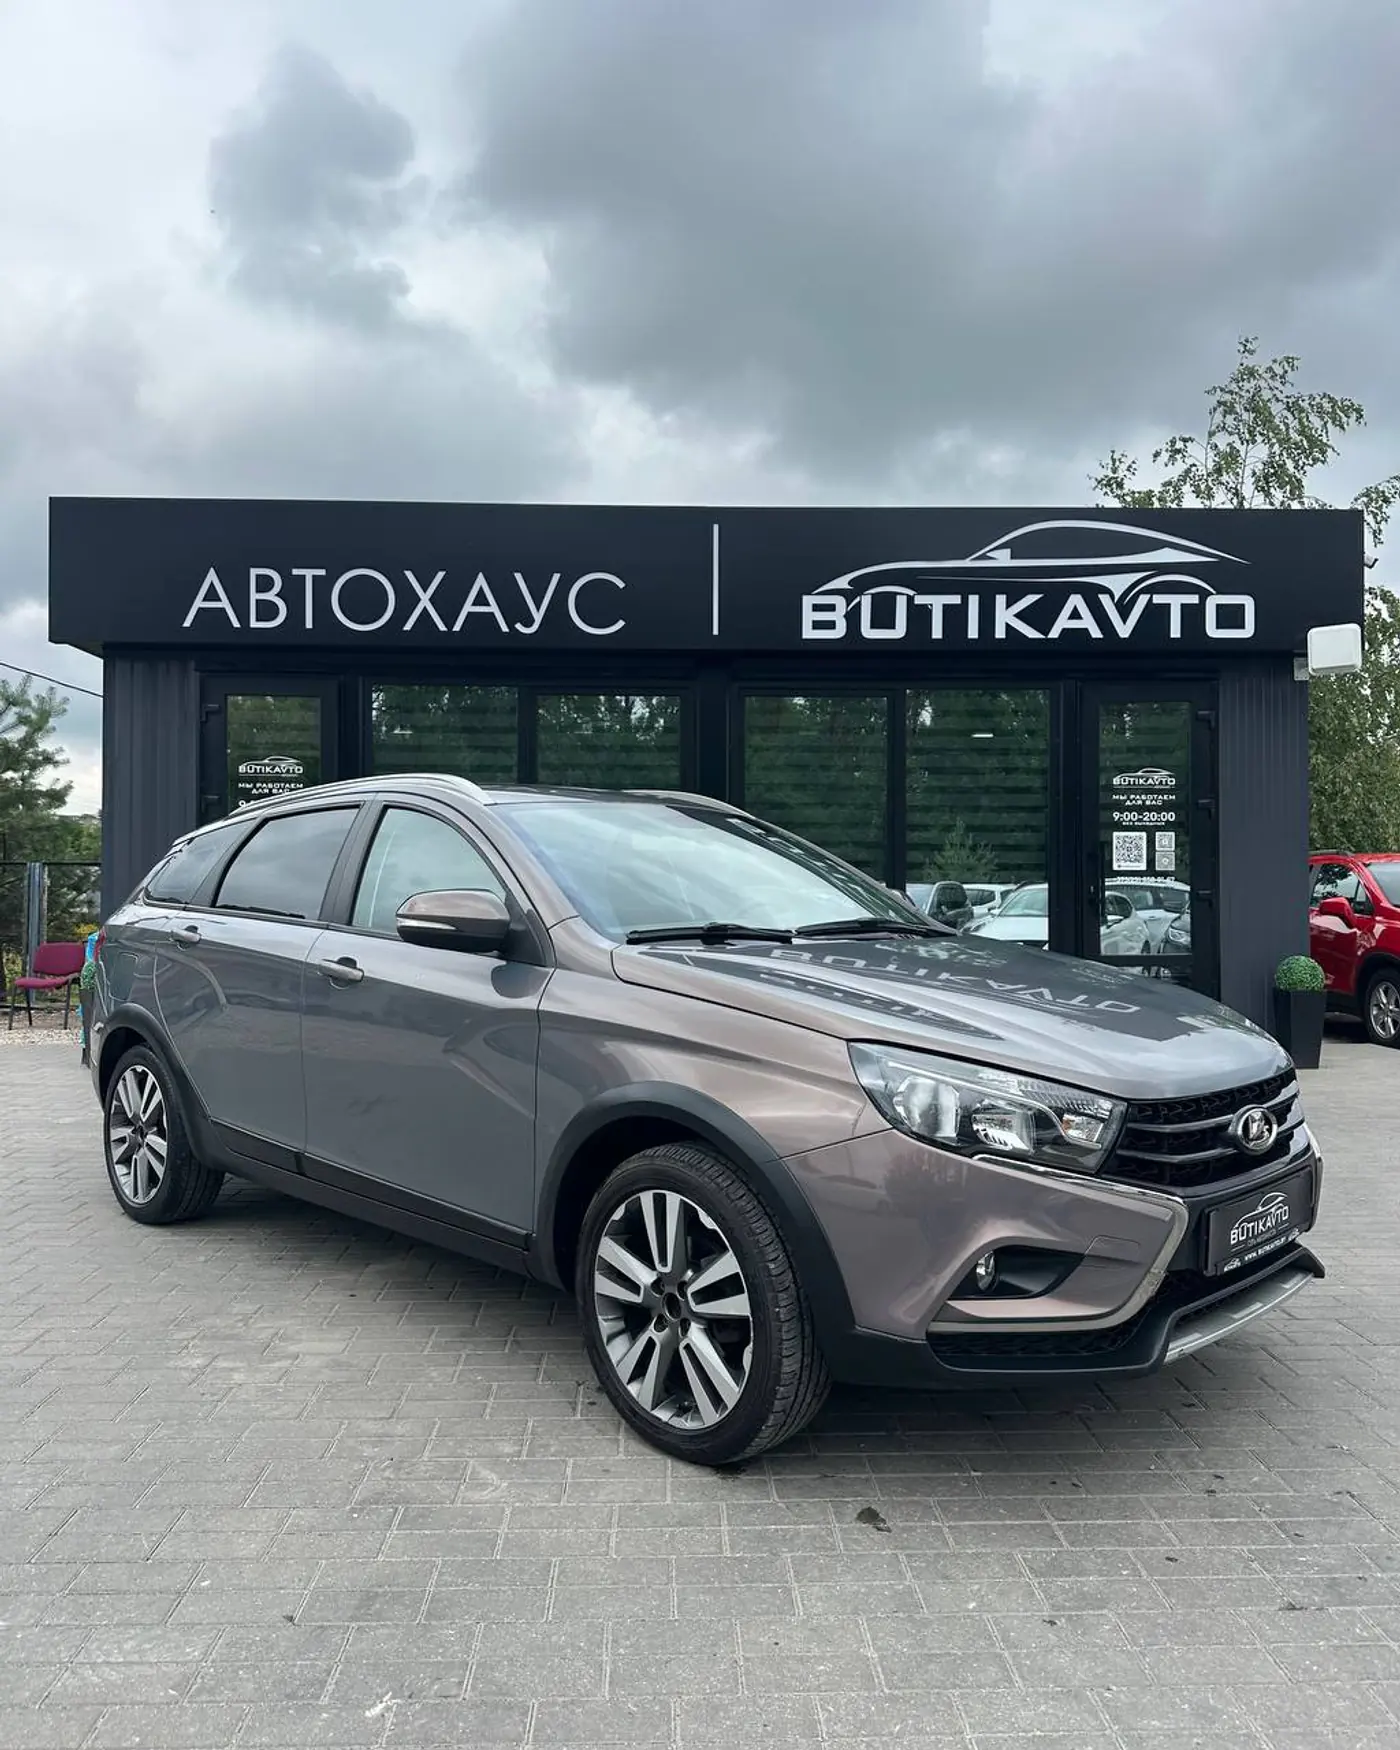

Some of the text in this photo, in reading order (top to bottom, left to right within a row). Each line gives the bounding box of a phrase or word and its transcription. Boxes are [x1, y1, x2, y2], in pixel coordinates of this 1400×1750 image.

[182, 566, 626, 635] АВТОХАУС
[801, 593, 1256, 640] BUTIKAVTO
[238, 765, 304, 774] BUTIKAVTO
[1113, 777, 1176, 785] BUTIKAVTO
[1113, 812, 1176, 821] 9:00-20:00
[1230, 1205, 1289, 1245] BUTIKAVTO
